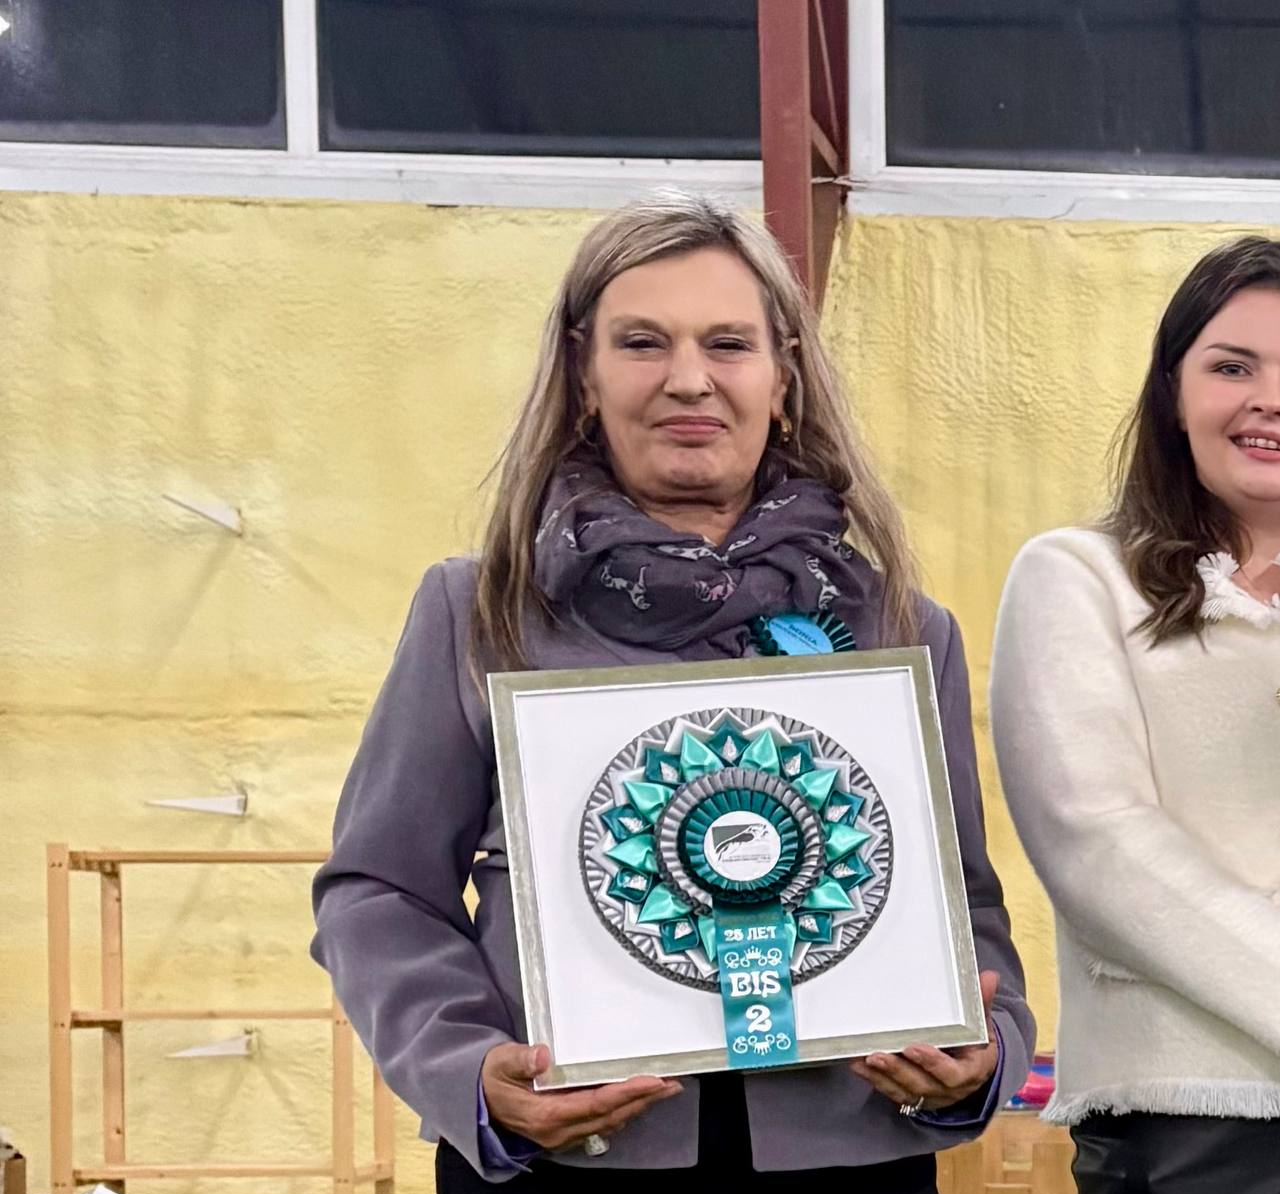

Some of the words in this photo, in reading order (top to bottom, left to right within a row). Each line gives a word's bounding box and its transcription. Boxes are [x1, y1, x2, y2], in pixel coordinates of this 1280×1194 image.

[746, 925, 777, 941] ЛЕТ
[728, 969, 781, 998] BIS
[744, 1003, 773, 1033] 2
